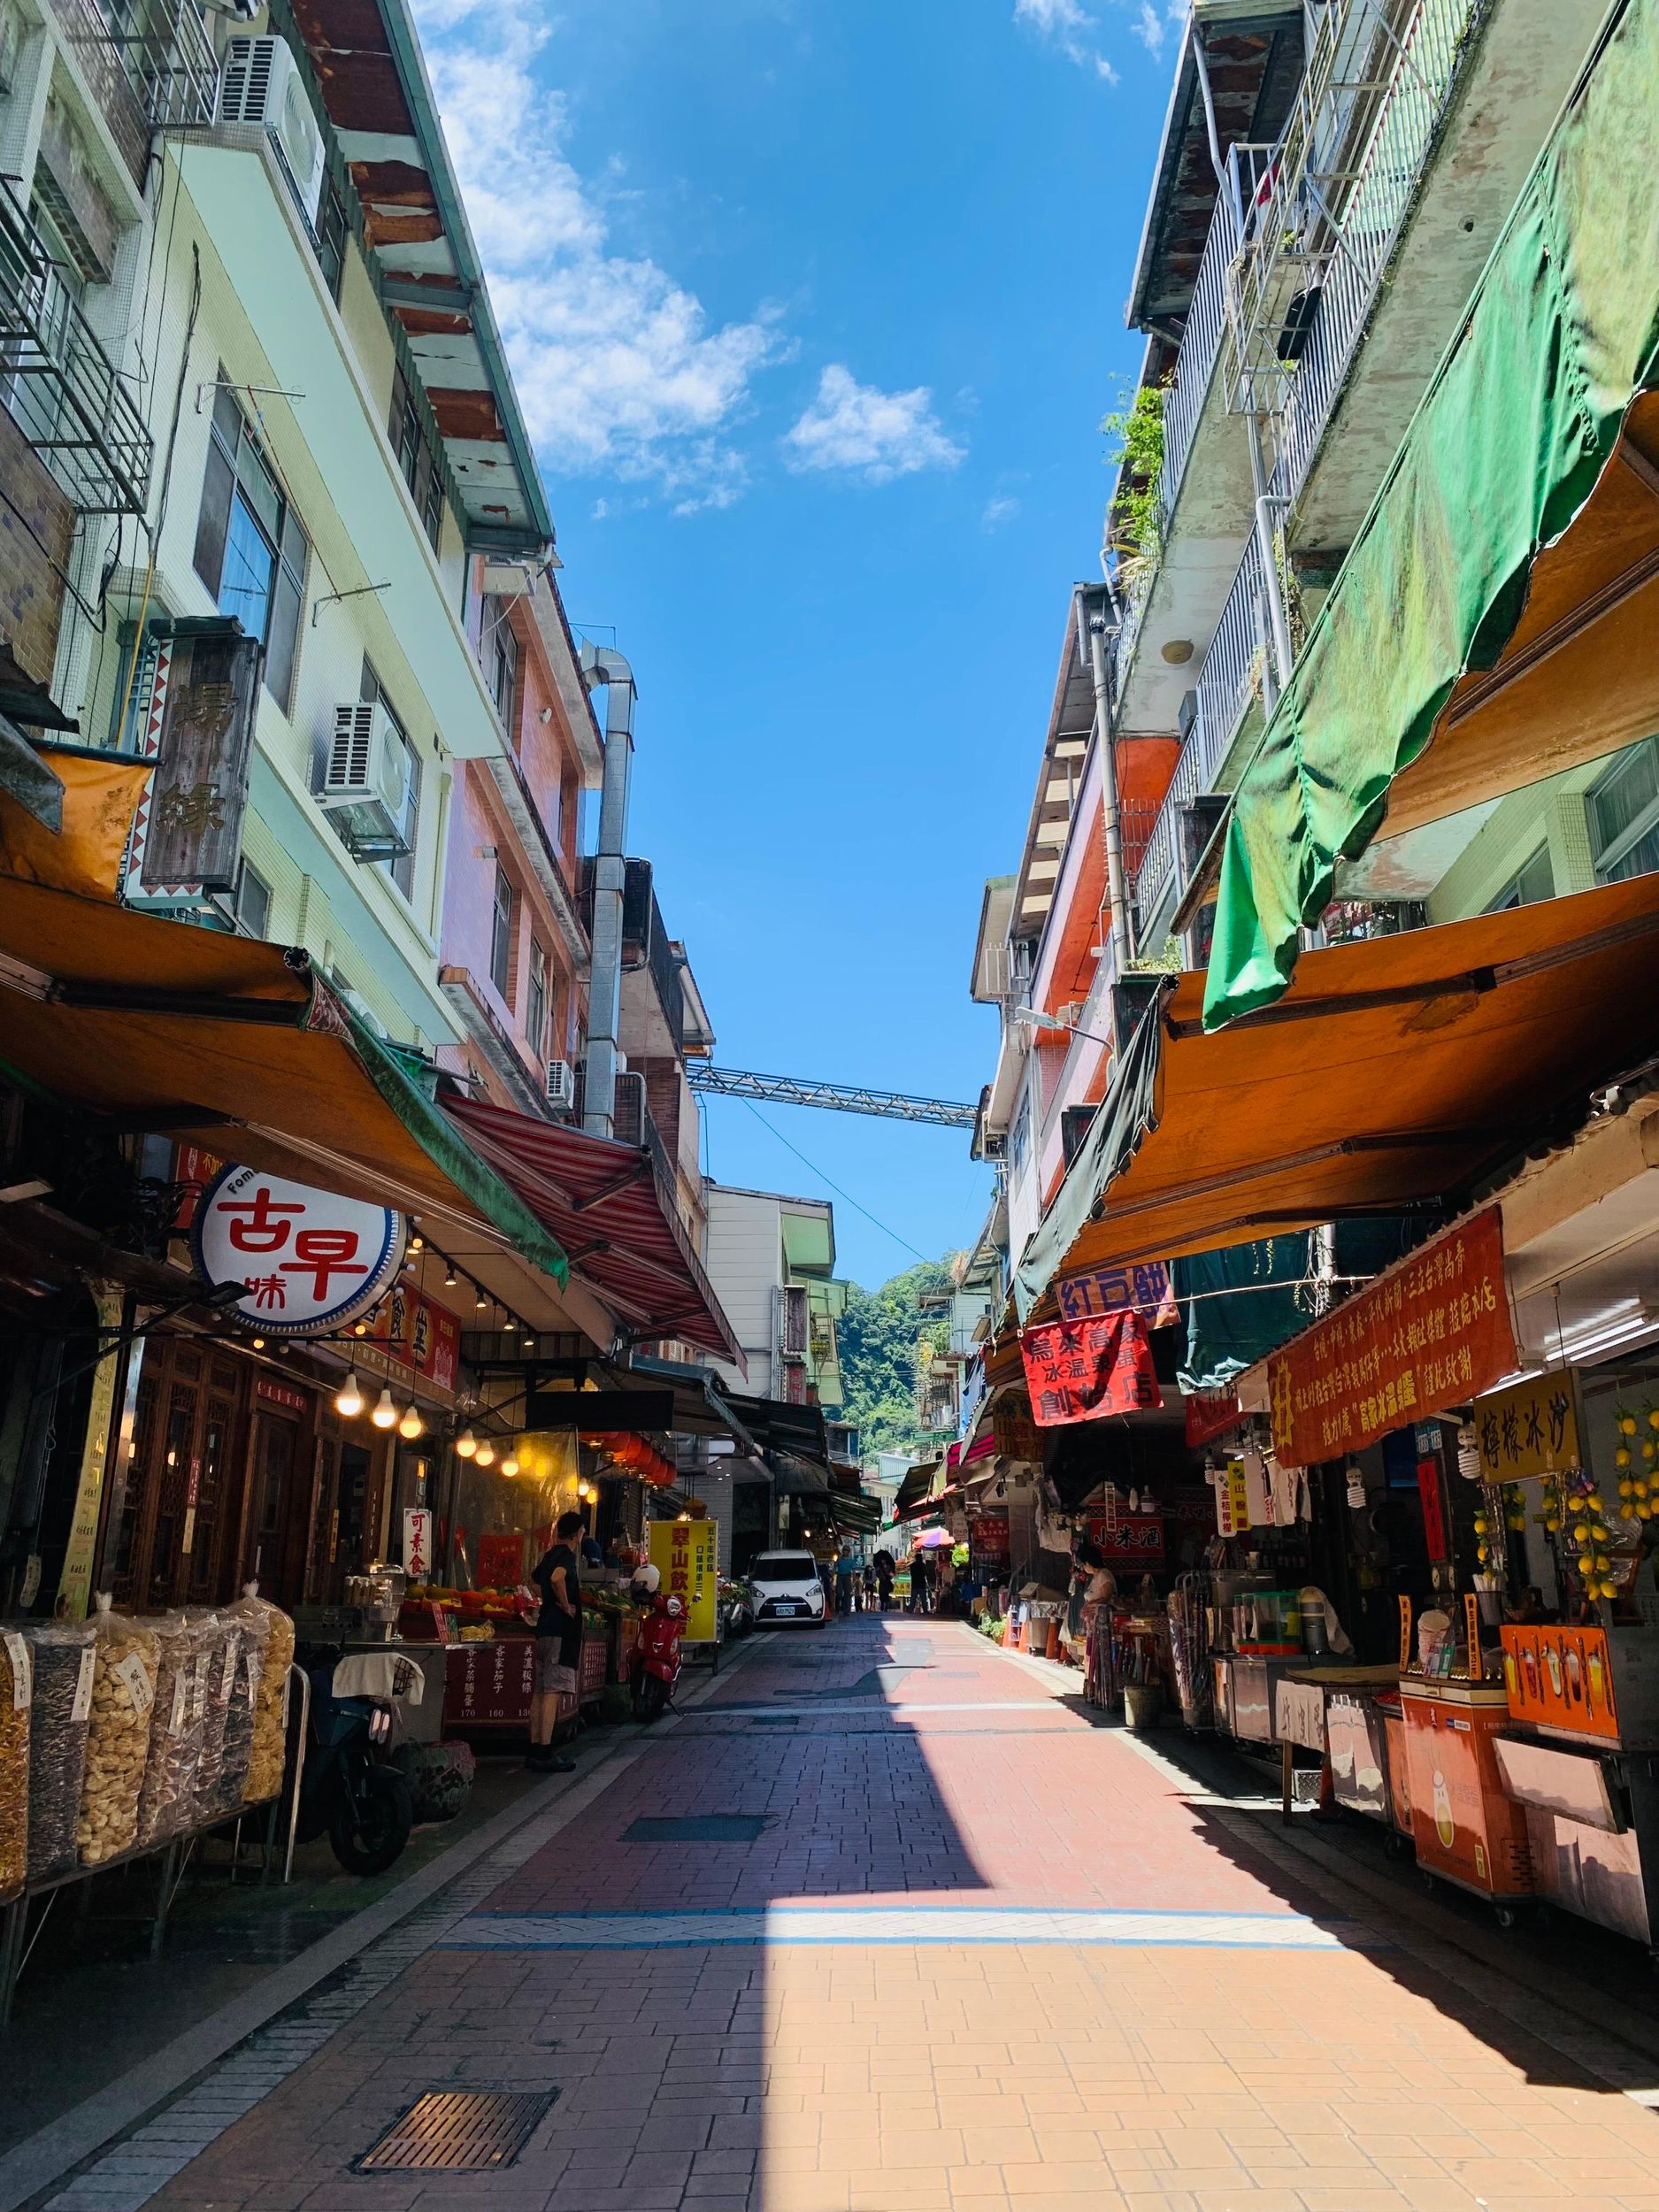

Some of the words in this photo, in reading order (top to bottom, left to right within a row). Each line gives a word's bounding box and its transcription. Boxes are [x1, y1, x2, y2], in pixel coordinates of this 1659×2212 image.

[1060, 1261, 1173, 1319] 紅豆餅
[1038, 1372, 1154, 1420] 創始店
[1481, 1390, 1571, 1471] 檸檬冰沙
[409, 1514, 426, 1574] 可素食
[1094, 1523, 1162, 1550] 小米酒
[493, 1645, 506, 1694] 客家茄子
[460, 1709, 476, 1717] 170
